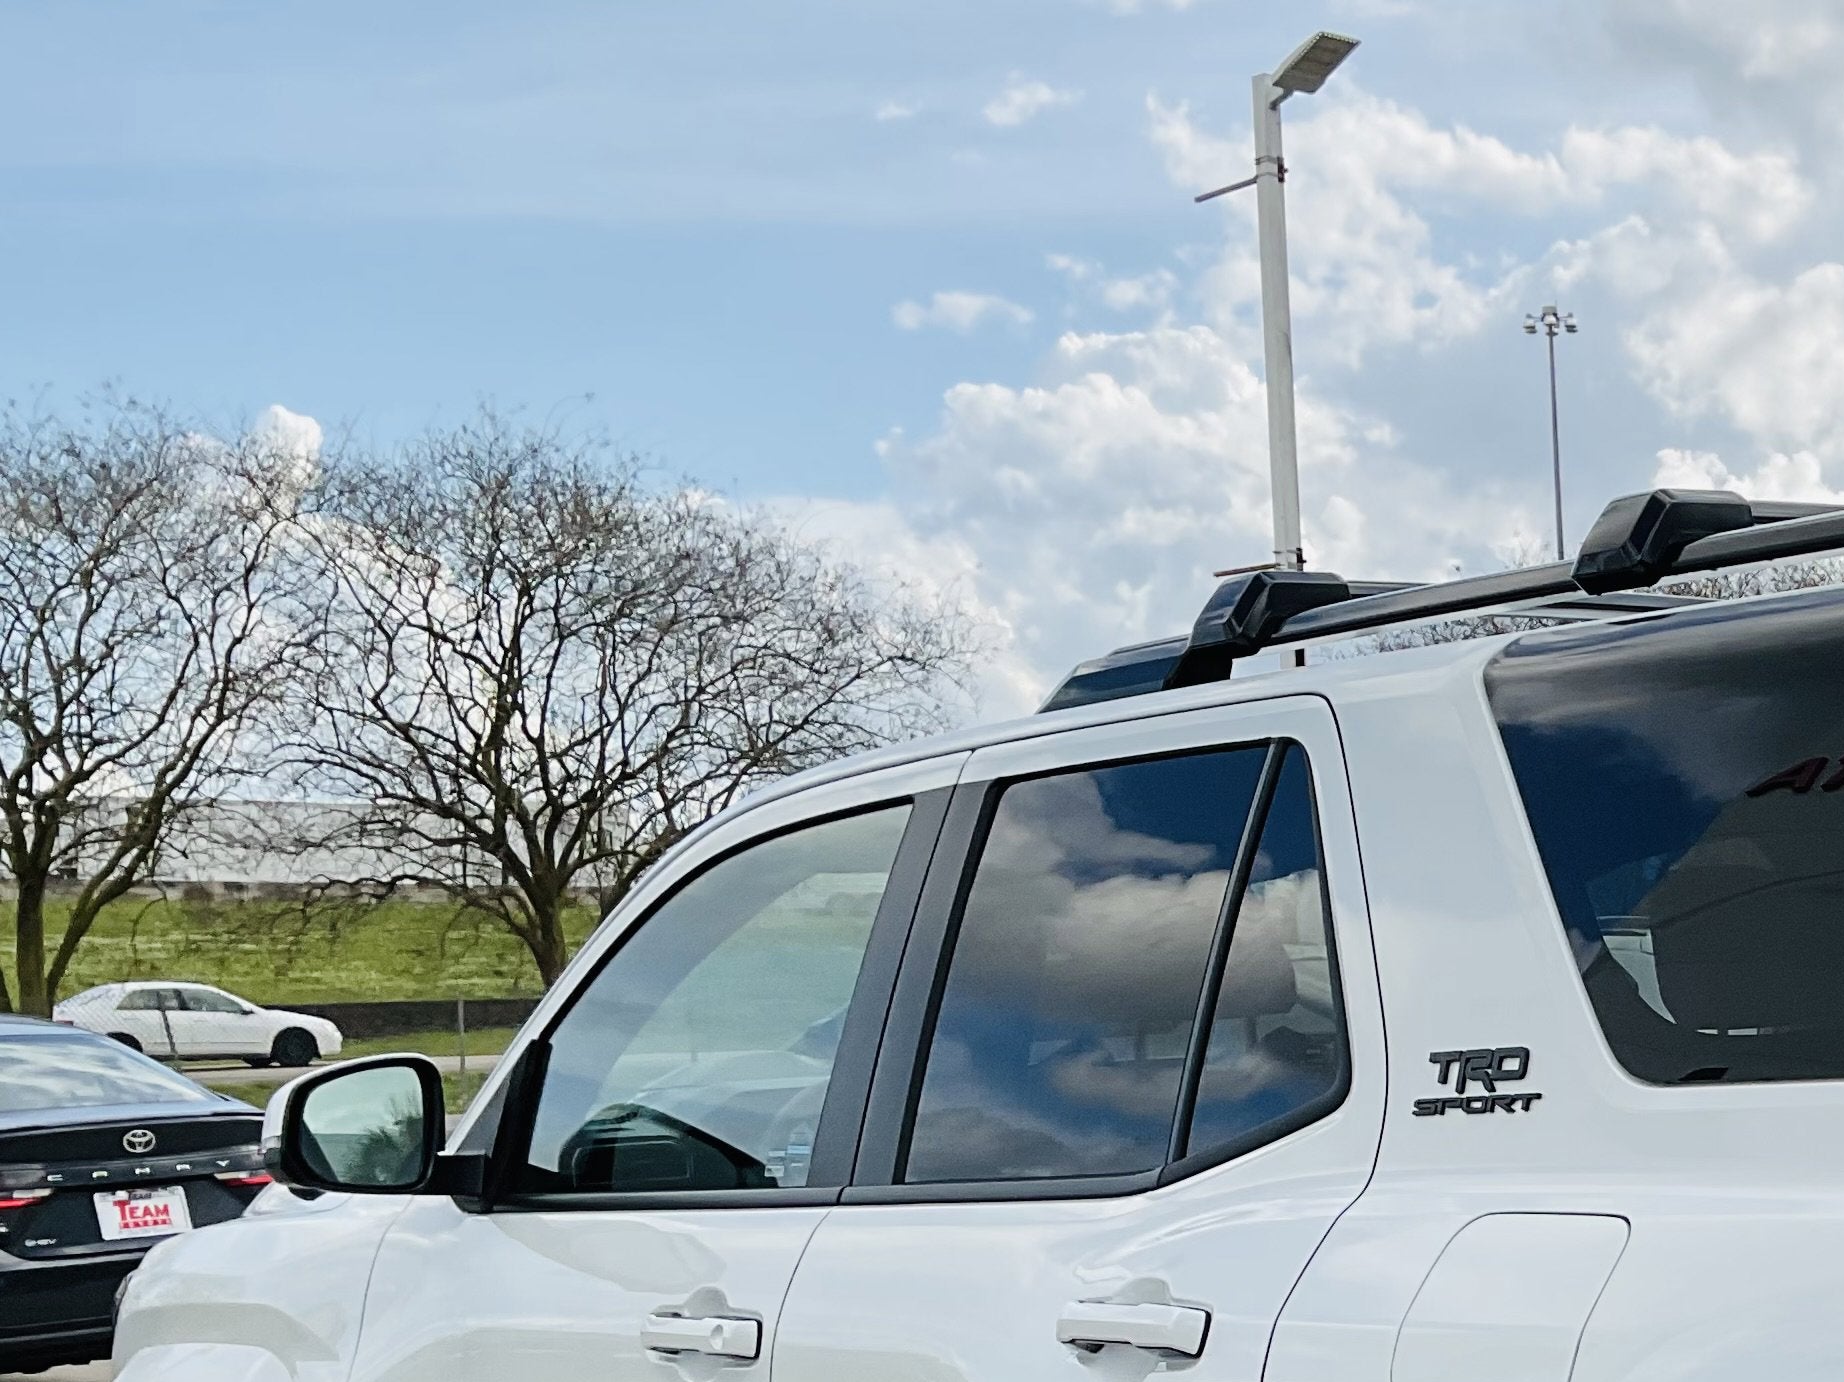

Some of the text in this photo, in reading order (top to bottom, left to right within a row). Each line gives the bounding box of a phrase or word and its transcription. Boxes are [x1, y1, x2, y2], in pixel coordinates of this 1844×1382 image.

[1429, 1046, 1530, 1094] TRD
[1412, 1092, 1542, 1116] SPORT
[47, 1160, 230, 1181] CAMRY
[112, 1200, 170, 1221] TEAM
